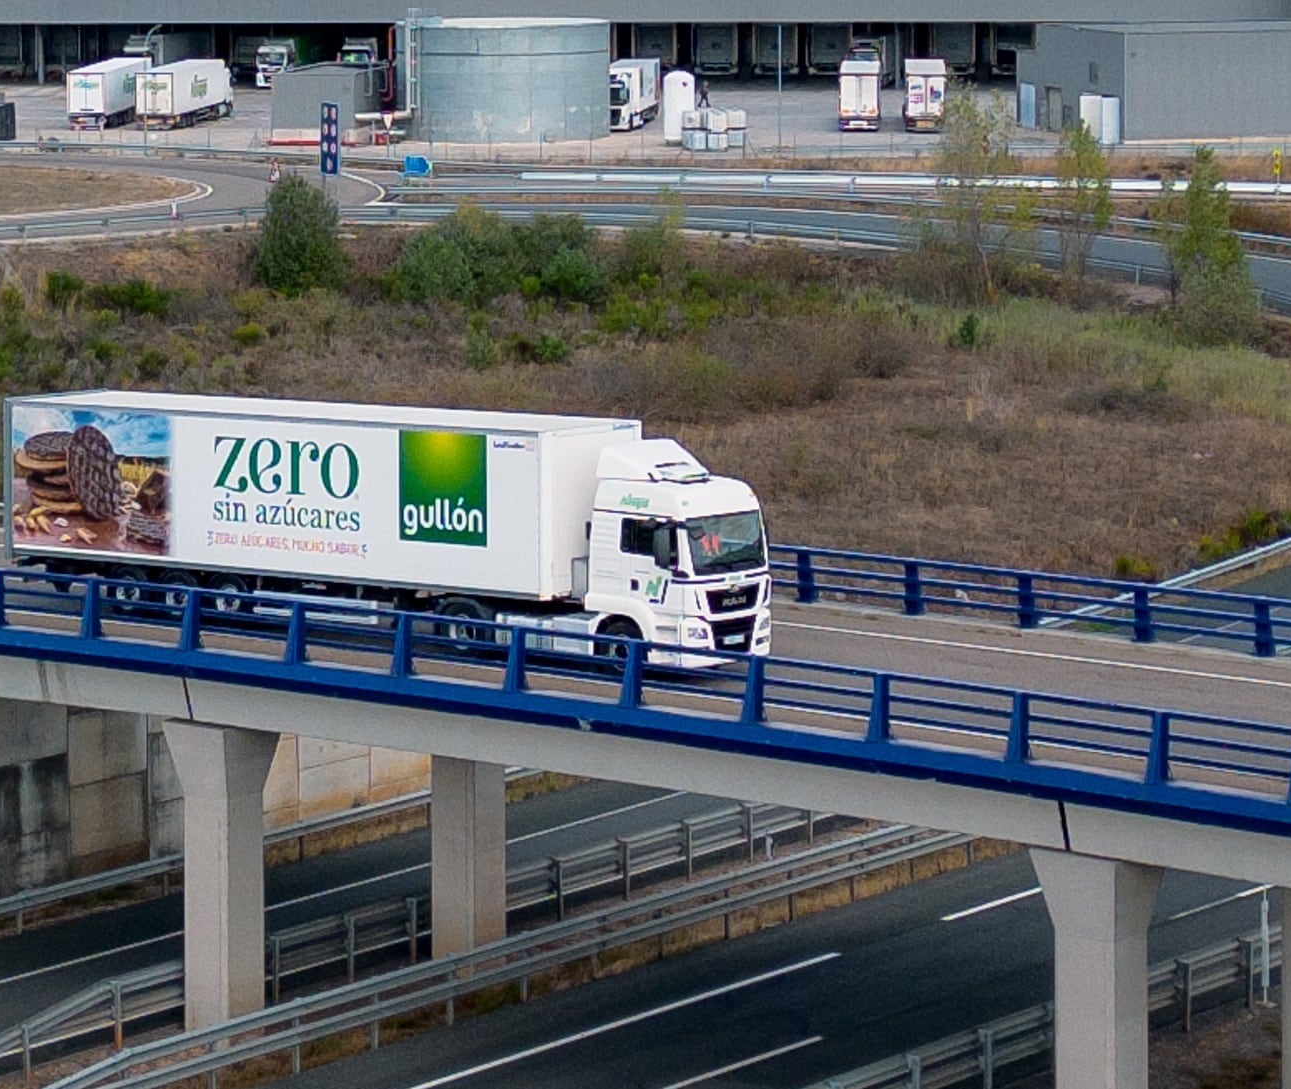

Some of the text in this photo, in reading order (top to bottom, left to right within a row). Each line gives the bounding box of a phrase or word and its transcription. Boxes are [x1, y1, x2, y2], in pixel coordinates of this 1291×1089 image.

[213, 436, 360, 499] zero
[213, 492, 361, 532] sin azúcares
[403, 496, 484, 536] gullón
[214, 532, 239, 545] ZERO
